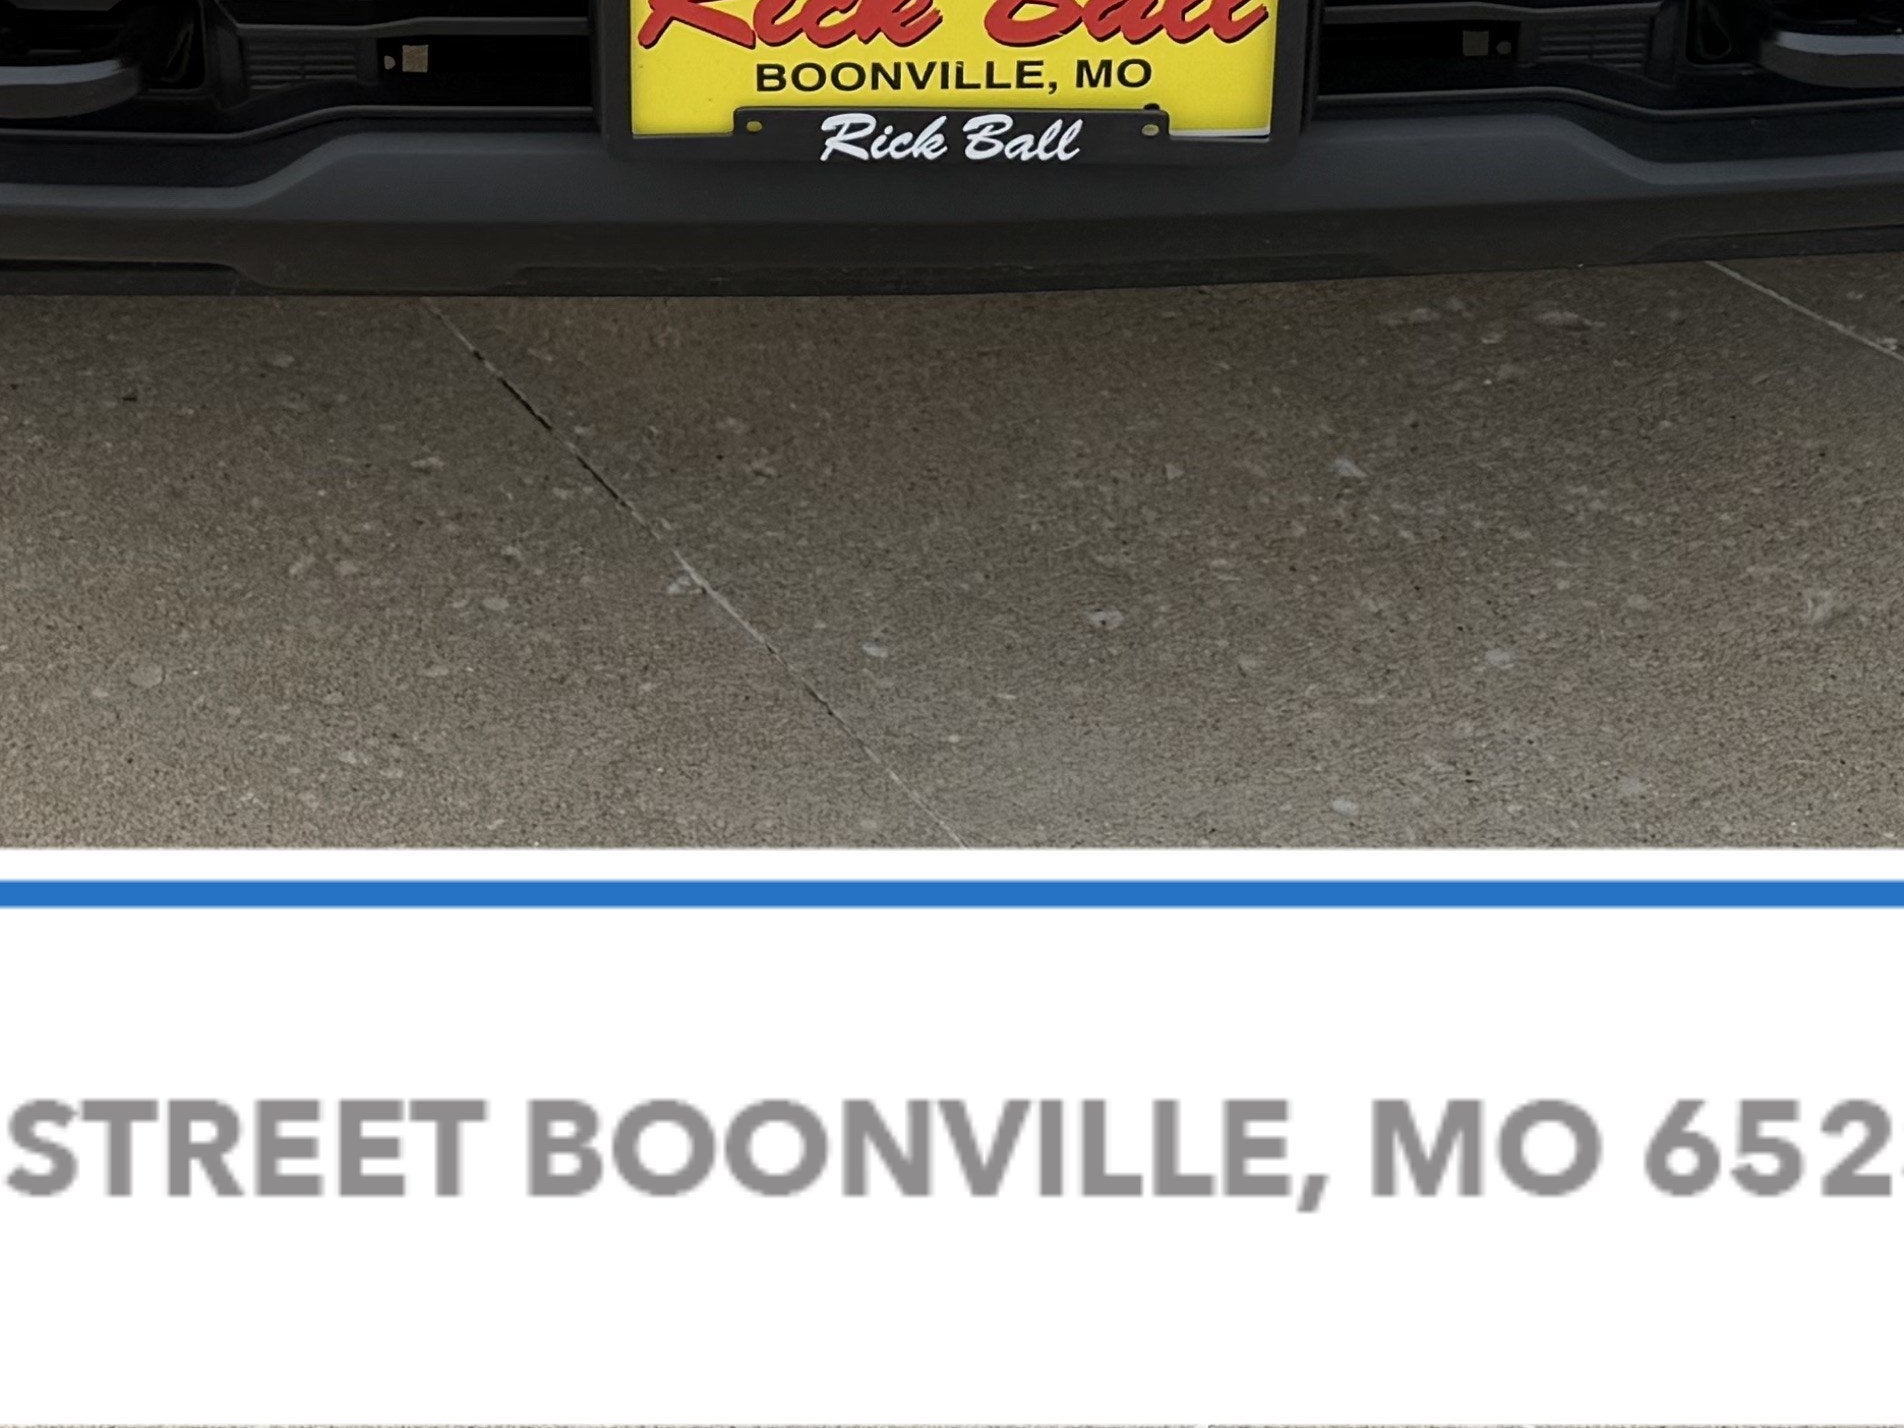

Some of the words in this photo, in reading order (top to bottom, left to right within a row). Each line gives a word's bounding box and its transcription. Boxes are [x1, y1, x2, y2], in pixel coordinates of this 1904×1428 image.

[756, 60, 1058, 95] BOONVILLE,
[1075, 58, 1152, 88] MO
[819, 112, 948, 162] Rick
[962, 113, 1084, 162] Ball
